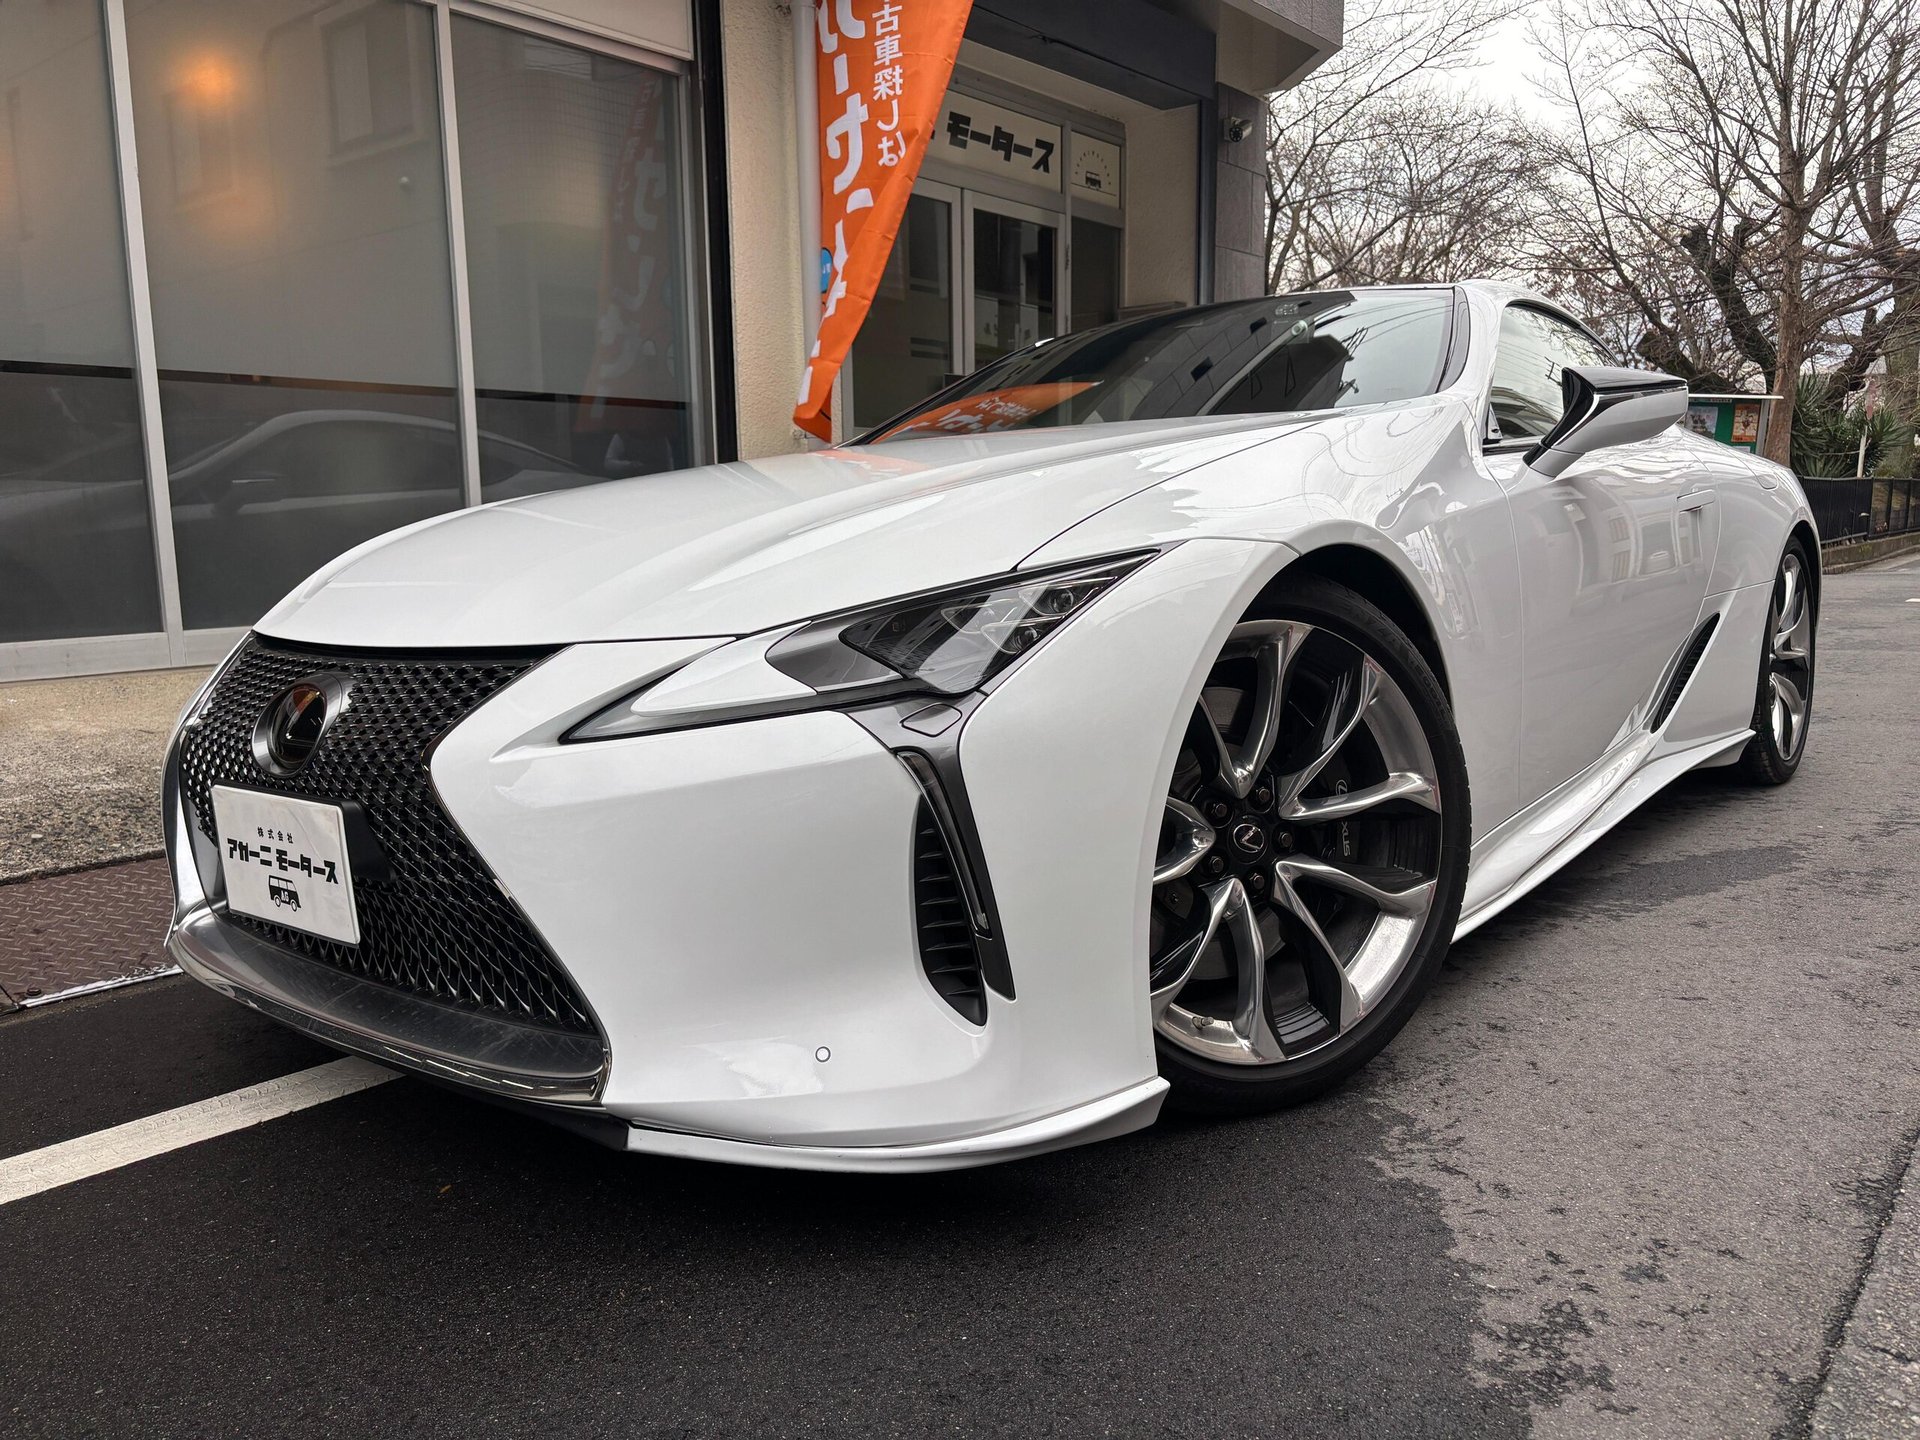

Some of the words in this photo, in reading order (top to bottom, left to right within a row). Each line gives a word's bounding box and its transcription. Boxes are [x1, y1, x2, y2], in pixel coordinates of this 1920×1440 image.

[946, 111, 1055, 174] モータース
[257, 826, 294, 844] 株式会社
[275, 848, 338, 884] モータース
